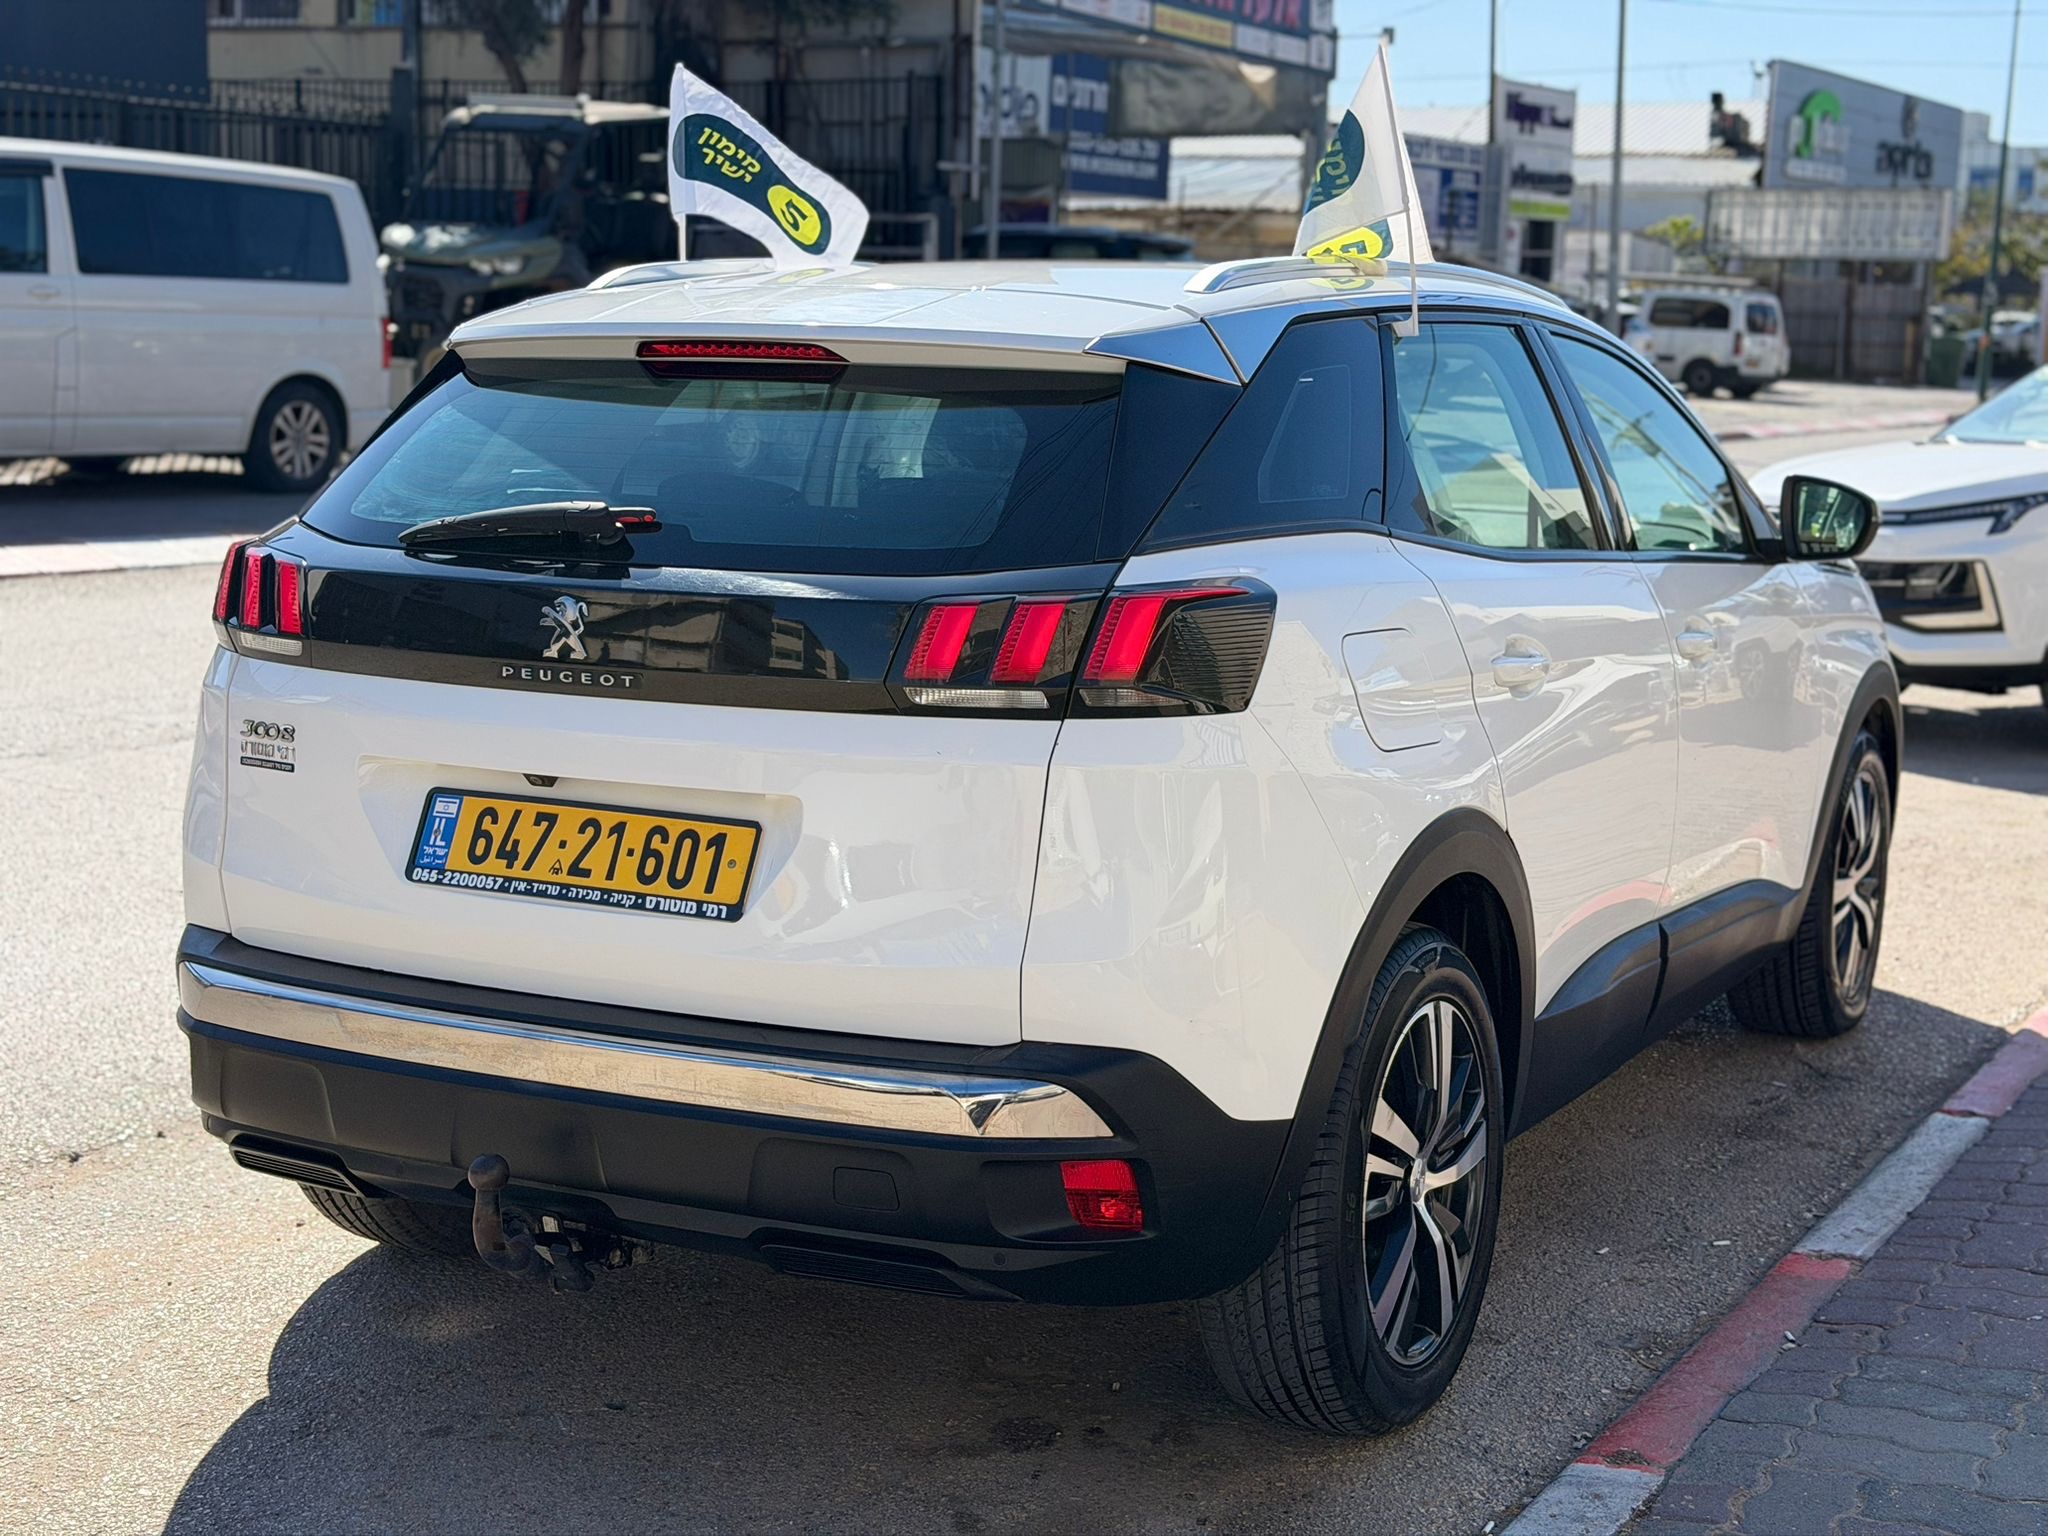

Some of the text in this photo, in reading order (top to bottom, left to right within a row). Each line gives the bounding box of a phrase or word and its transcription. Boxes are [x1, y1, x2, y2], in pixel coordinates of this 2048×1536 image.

[698, 127, 762, 173] מימון
[703, 147, 753, 184] ישיר
[502, 665, 635, 688] PEUGEOT
[240, 719, 296, 743] 3008
[429, 817, 447, 846] IL
[423, 845, 448, 856] ישראל
[412, 867, 728, 919] רמי מוטורס קניה מכירה טרייד-אין 055-2200057
